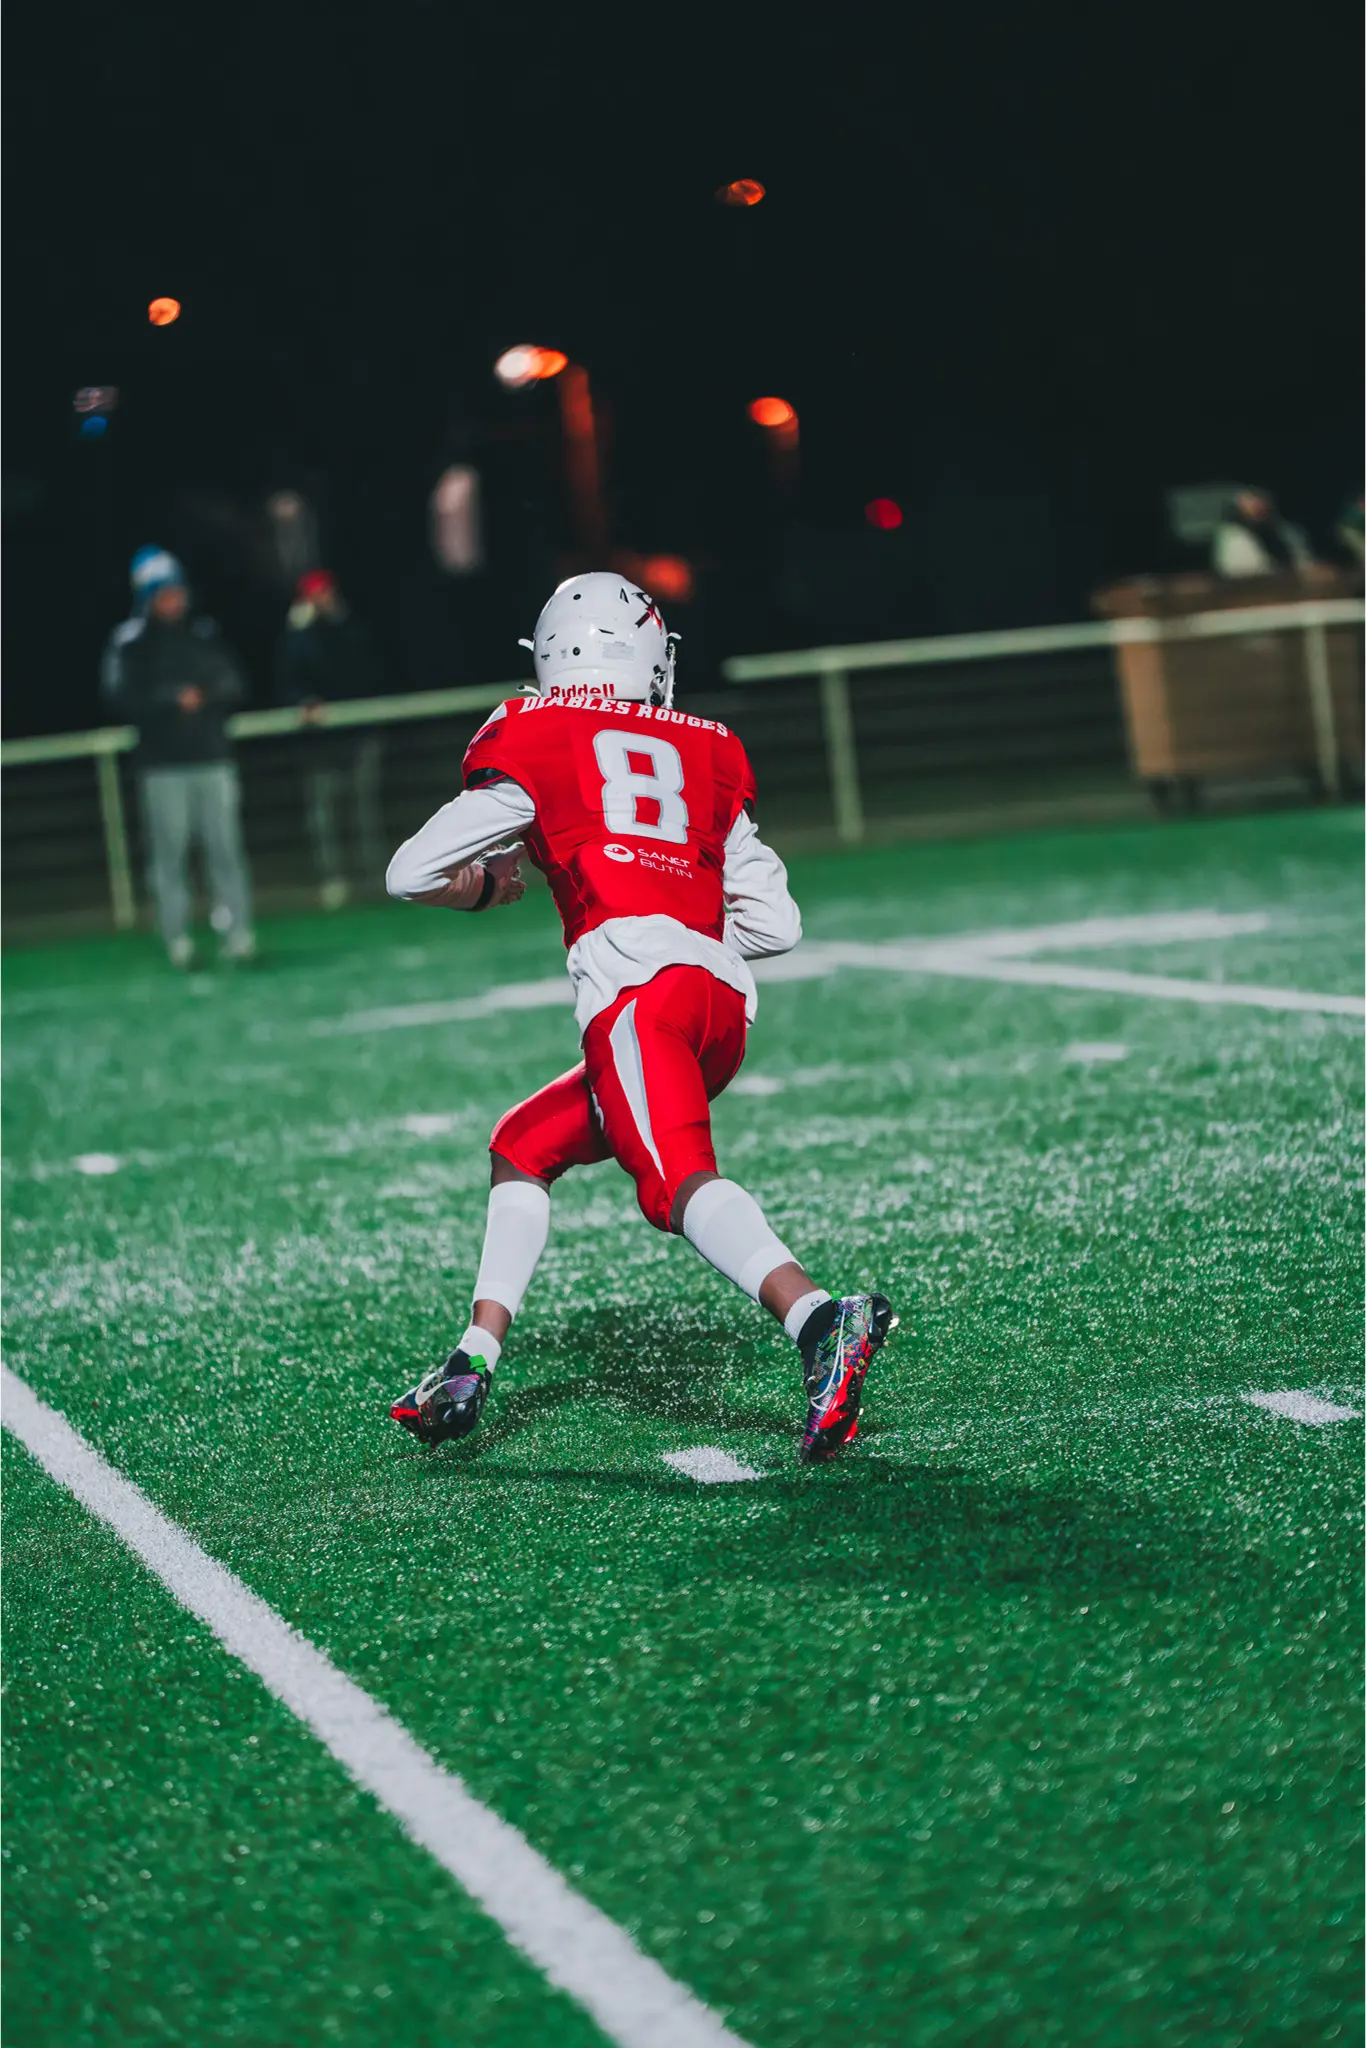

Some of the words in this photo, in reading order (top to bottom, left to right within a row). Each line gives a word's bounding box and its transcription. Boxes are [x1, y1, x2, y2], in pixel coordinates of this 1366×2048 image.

[550, 683, 615, 699] Riddell
[518, 696, 631, 715] DIABLES
[636, 703, 728, 738] ROUGES
[592, 729, 689, 844] 8
[640, 858, 693, 878] BUTIN
